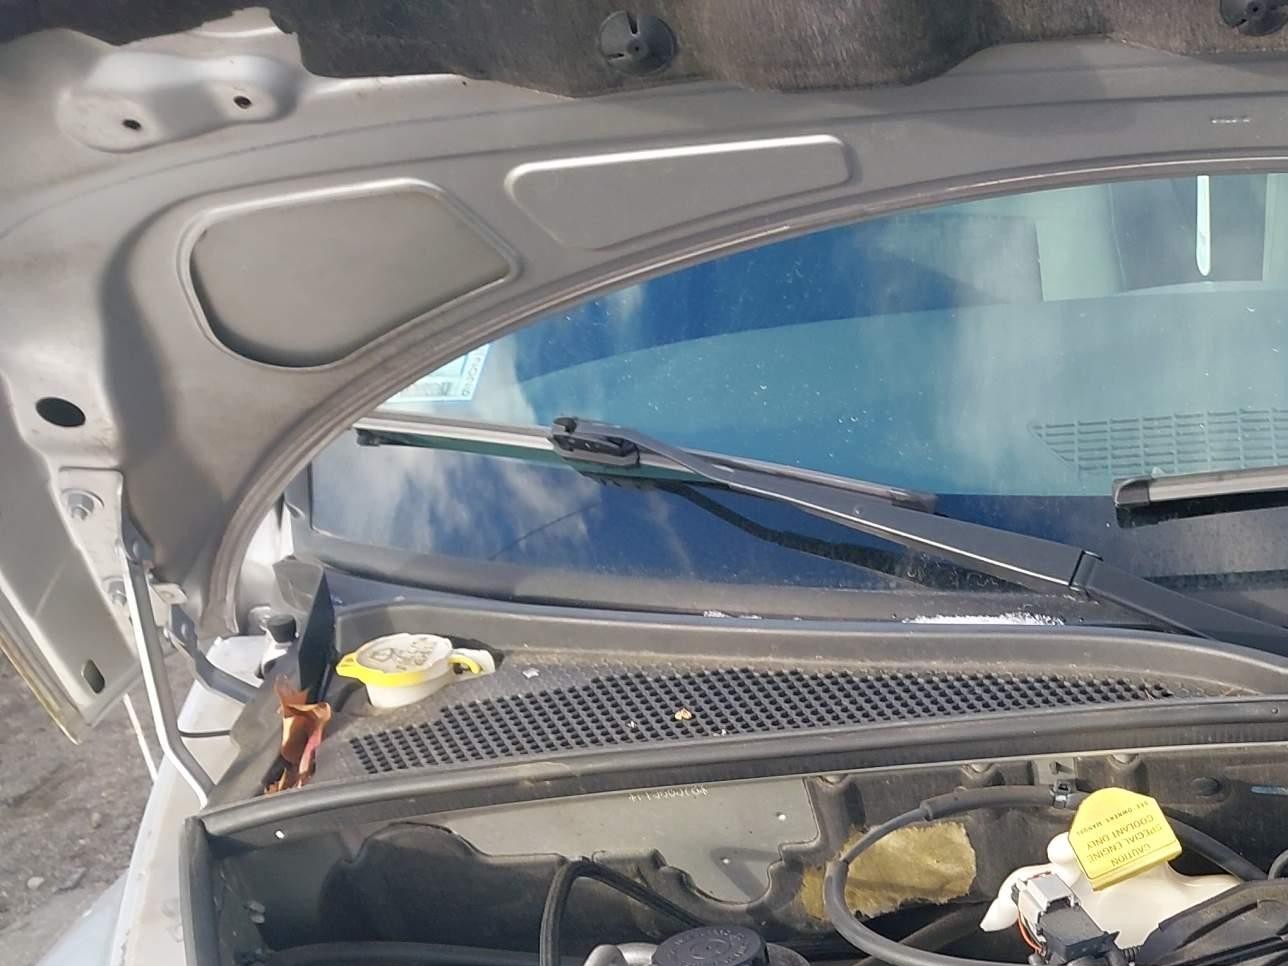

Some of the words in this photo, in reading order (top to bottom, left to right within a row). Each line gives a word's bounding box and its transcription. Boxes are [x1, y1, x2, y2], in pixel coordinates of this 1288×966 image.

[1111, 814, 1154, 838] COOLANT
[1124, 823, 1163, 846] SPECIAL
[1087, 834, 1110, 850] ONLY
[1087, 842, 1123, 863] ENGINE
[1110, 843, 1151, 867] CAUTION
